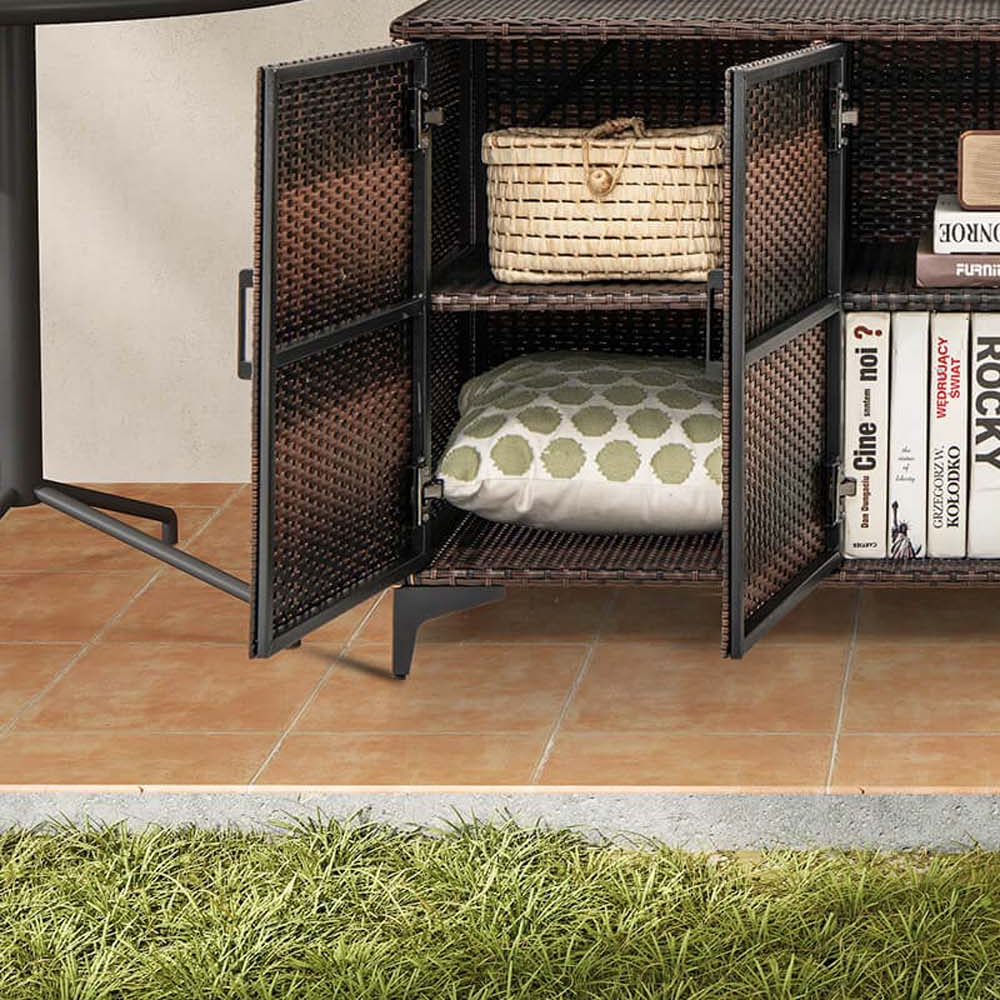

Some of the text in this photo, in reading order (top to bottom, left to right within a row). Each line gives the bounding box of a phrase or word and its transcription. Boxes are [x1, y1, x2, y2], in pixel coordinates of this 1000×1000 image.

[854, 347, 878, 382] noi
[949, 357, 961, 399] ŚWIAT
[853, 422, 877, 471] Cine
